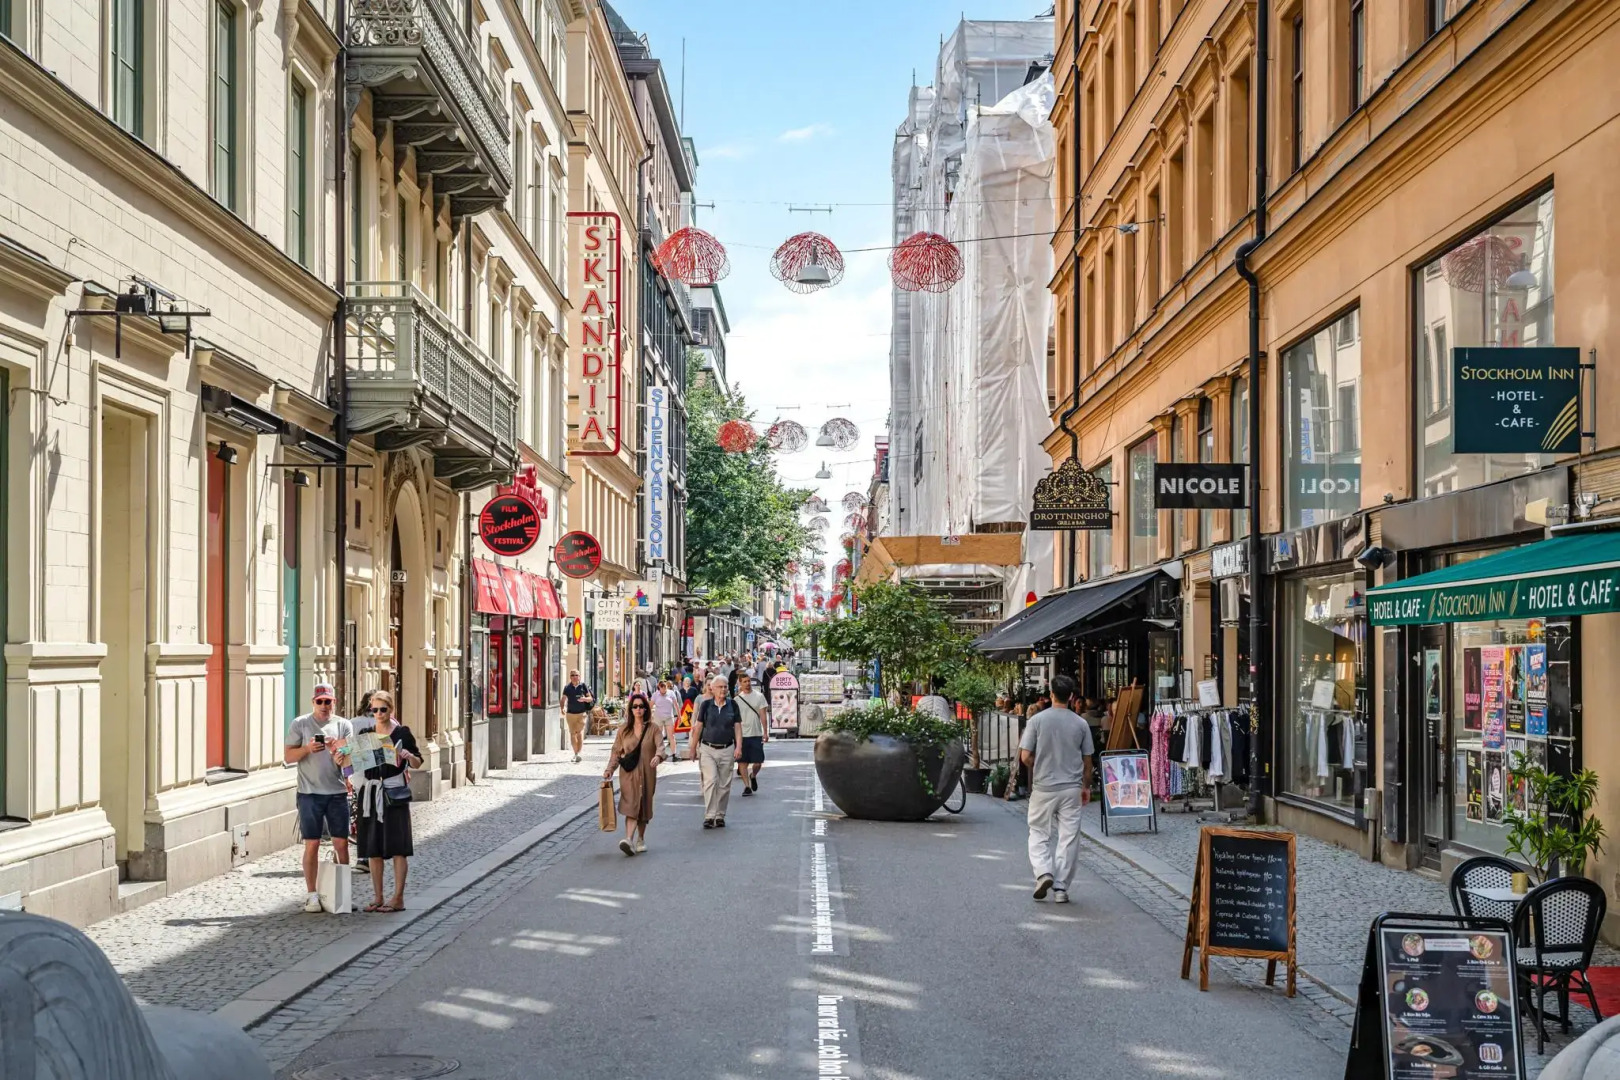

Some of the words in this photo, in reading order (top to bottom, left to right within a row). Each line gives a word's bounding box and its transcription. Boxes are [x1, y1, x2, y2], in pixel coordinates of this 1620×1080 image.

[581, 226, 604, 440] SKANDIA
[1461, 366, 1542, 380] STOCKHOLM
[1548, 366, 1574, 380] INN
[1513, 404, 1521, 414] &
[650, 389, 663, 558] SIDENCARLSON
[1160, 478, 1239, 494] NICOLE
[484, 514, 535, 536] Stockholm
[1034, 512, 1110, 520] DROTTNINGHOF
[494, 537, 524, 545] FESTIVAL
[1212, 544, 1244, 577] NICOLE
[392, 572, 405, 581] 82
[1436, 592, 1486, 617] STOCKHOLM
[1488, 587, 1506, 613] INN
[1528, 584, 1563, 609] HOTEL
[1567, 582, 1576, 607] &
[1580, 579, 1612, 606] CAFE
[598, 600, 622, 608] CITY
[1373, 600, 1394, 619] HOTEL
[1395, 599, 1400, 617] &
[1402, 598, 1421, 618] CAFE
